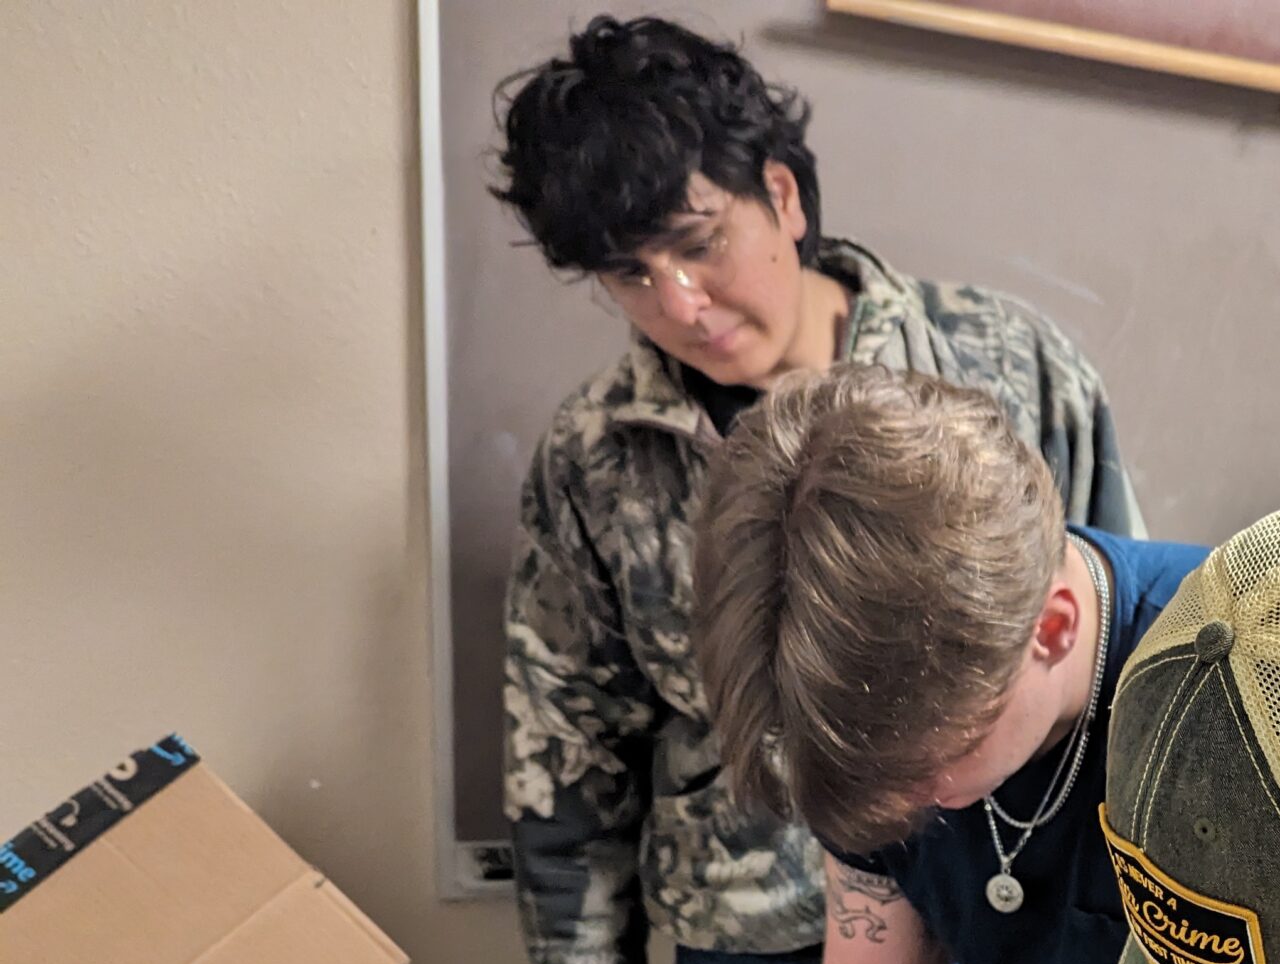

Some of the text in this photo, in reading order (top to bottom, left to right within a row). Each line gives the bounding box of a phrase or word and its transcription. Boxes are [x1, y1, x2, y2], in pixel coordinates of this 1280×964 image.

[0, 841, 36, 881] ime
[1127, 863, 1164, 900] NEVER
[1167, 897, 1177, 911] A
[1142, 901, 1245, 957] Crime
